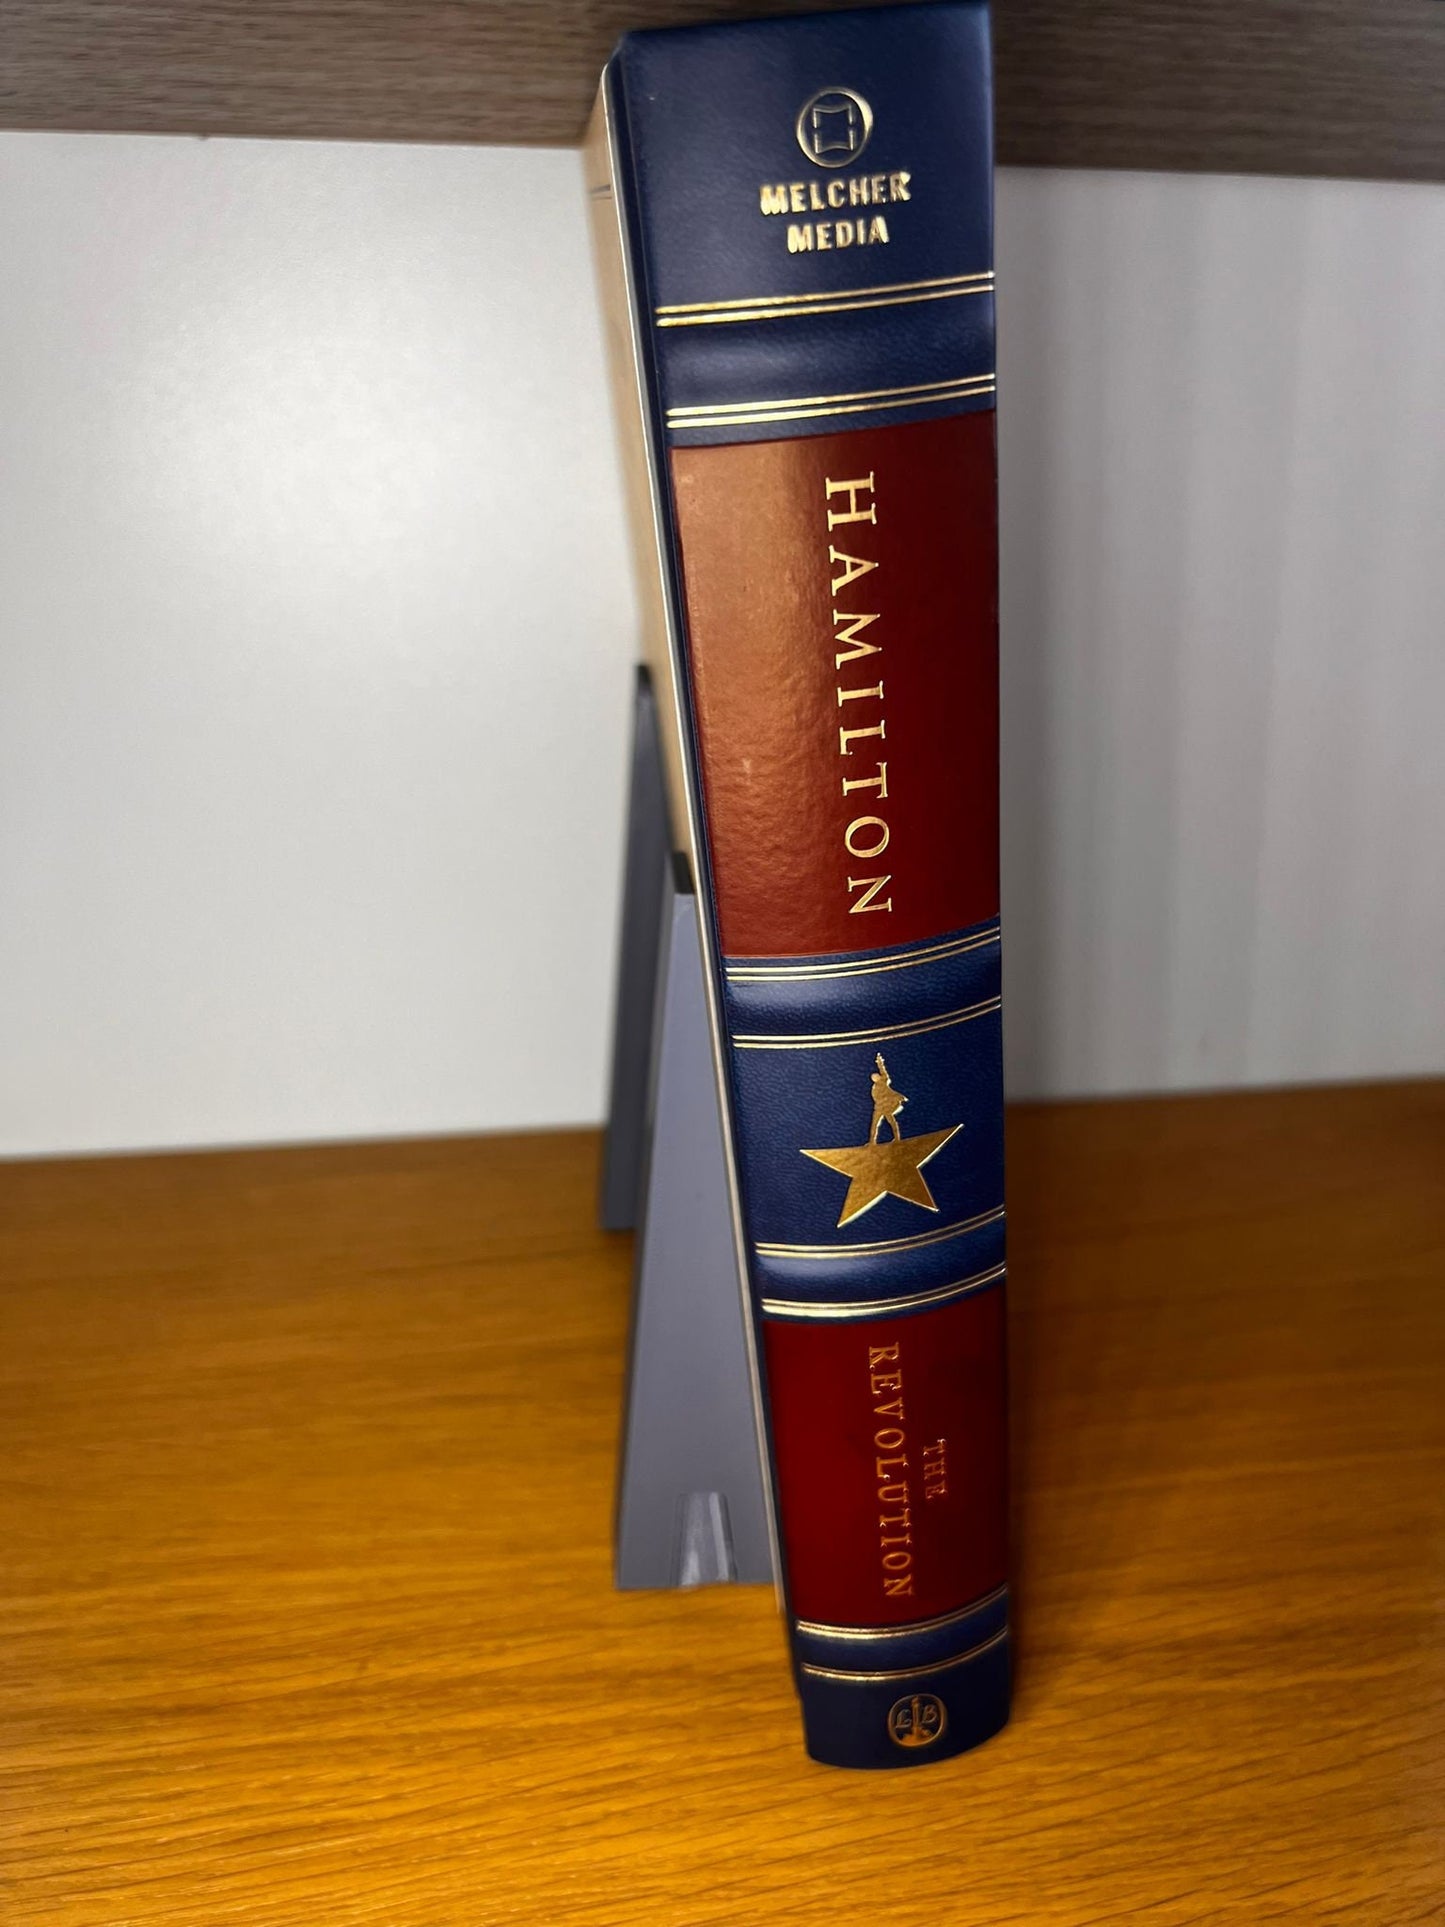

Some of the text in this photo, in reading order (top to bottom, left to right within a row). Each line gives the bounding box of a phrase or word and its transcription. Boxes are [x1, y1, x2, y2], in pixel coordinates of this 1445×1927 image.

[760, 172, 911, 215] MELCHER
[787, 215, 889, 253] MEDIA
[825, 471, 893, 914] HAMILTON
[869, 1342, 914, 1597] REVOLUTION
[923, 1438, 947, 1500] THE
